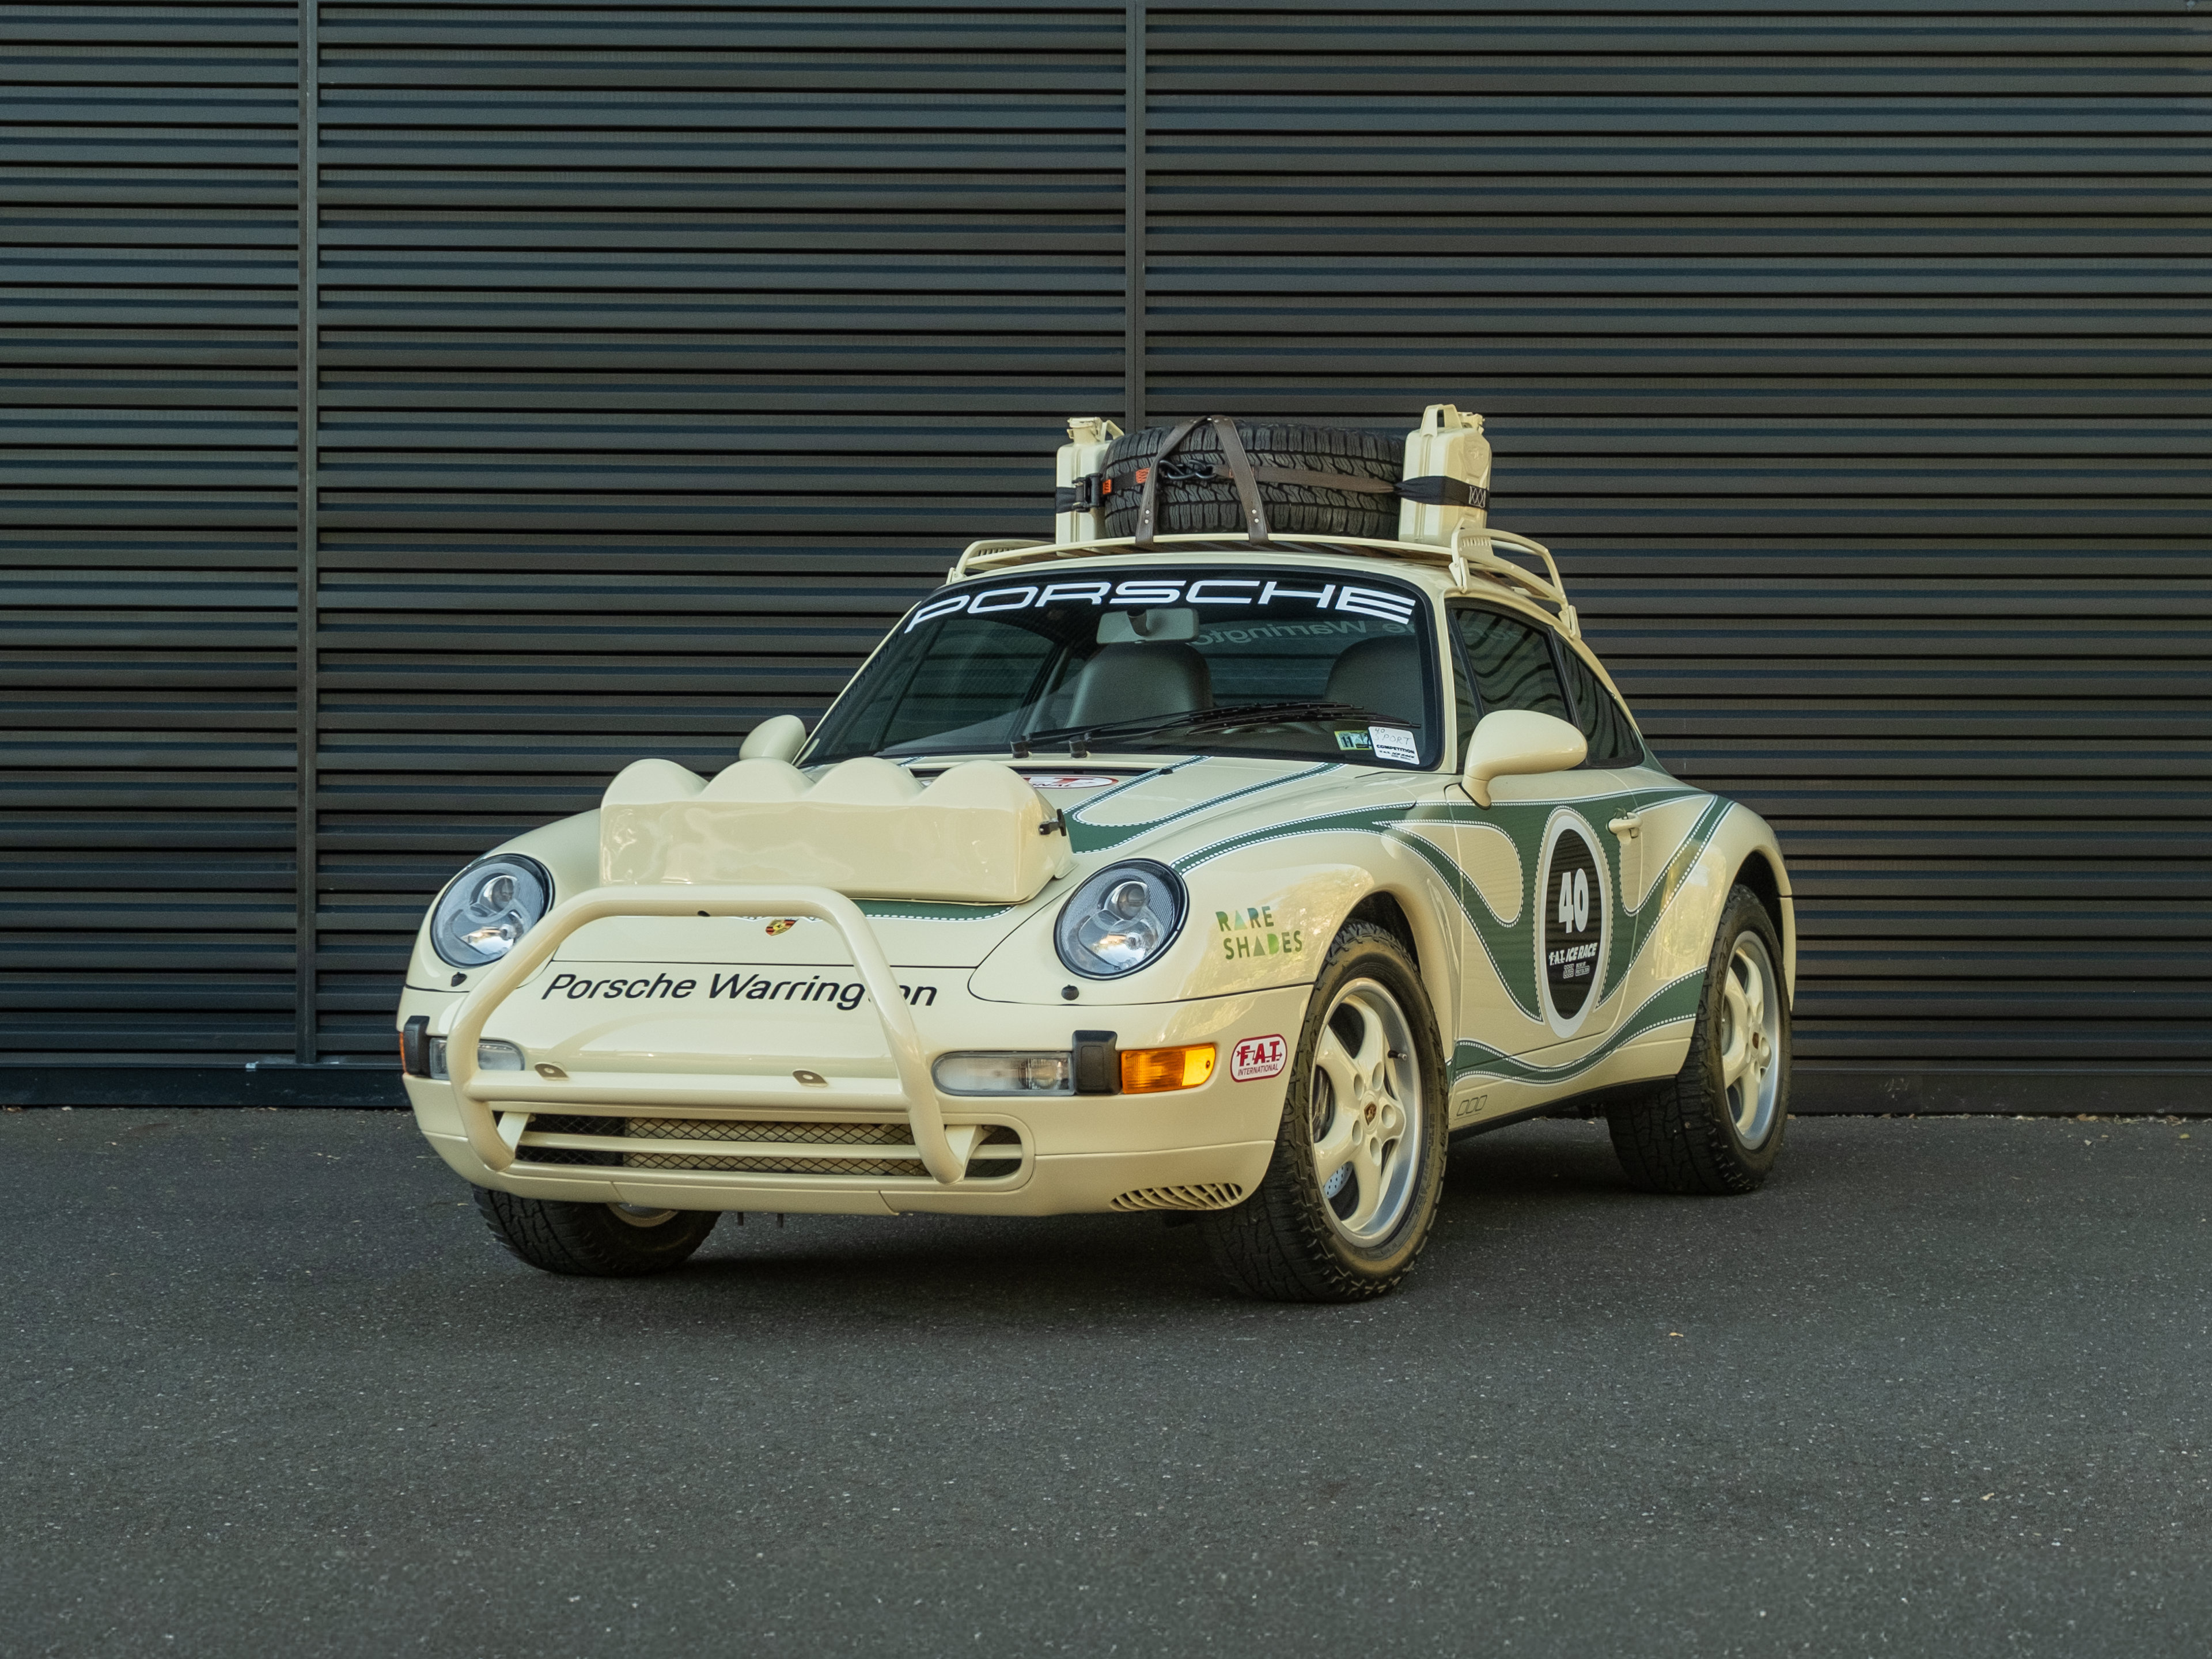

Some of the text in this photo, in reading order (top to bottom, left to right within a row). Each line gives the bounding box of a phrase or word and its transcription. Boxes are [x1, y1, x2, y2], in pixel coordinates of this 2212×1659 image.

[904, 580, 1416, 633] PORSCHE
[1376, 744, 1415, 755] COMPETITION
[1559, 868, 1589, 933] 40
[1215, 906, 1274, 932] RARE
[1223, 930, 1302, 960] SHADES
[1565, 946, 1579, 963] ICE
[1577, 942, 1598, 960] RACE
[541, 973, 937, 1011] Porsche Warringn
[1237, 1063, 1279, 1077] INTERNATIONAL
